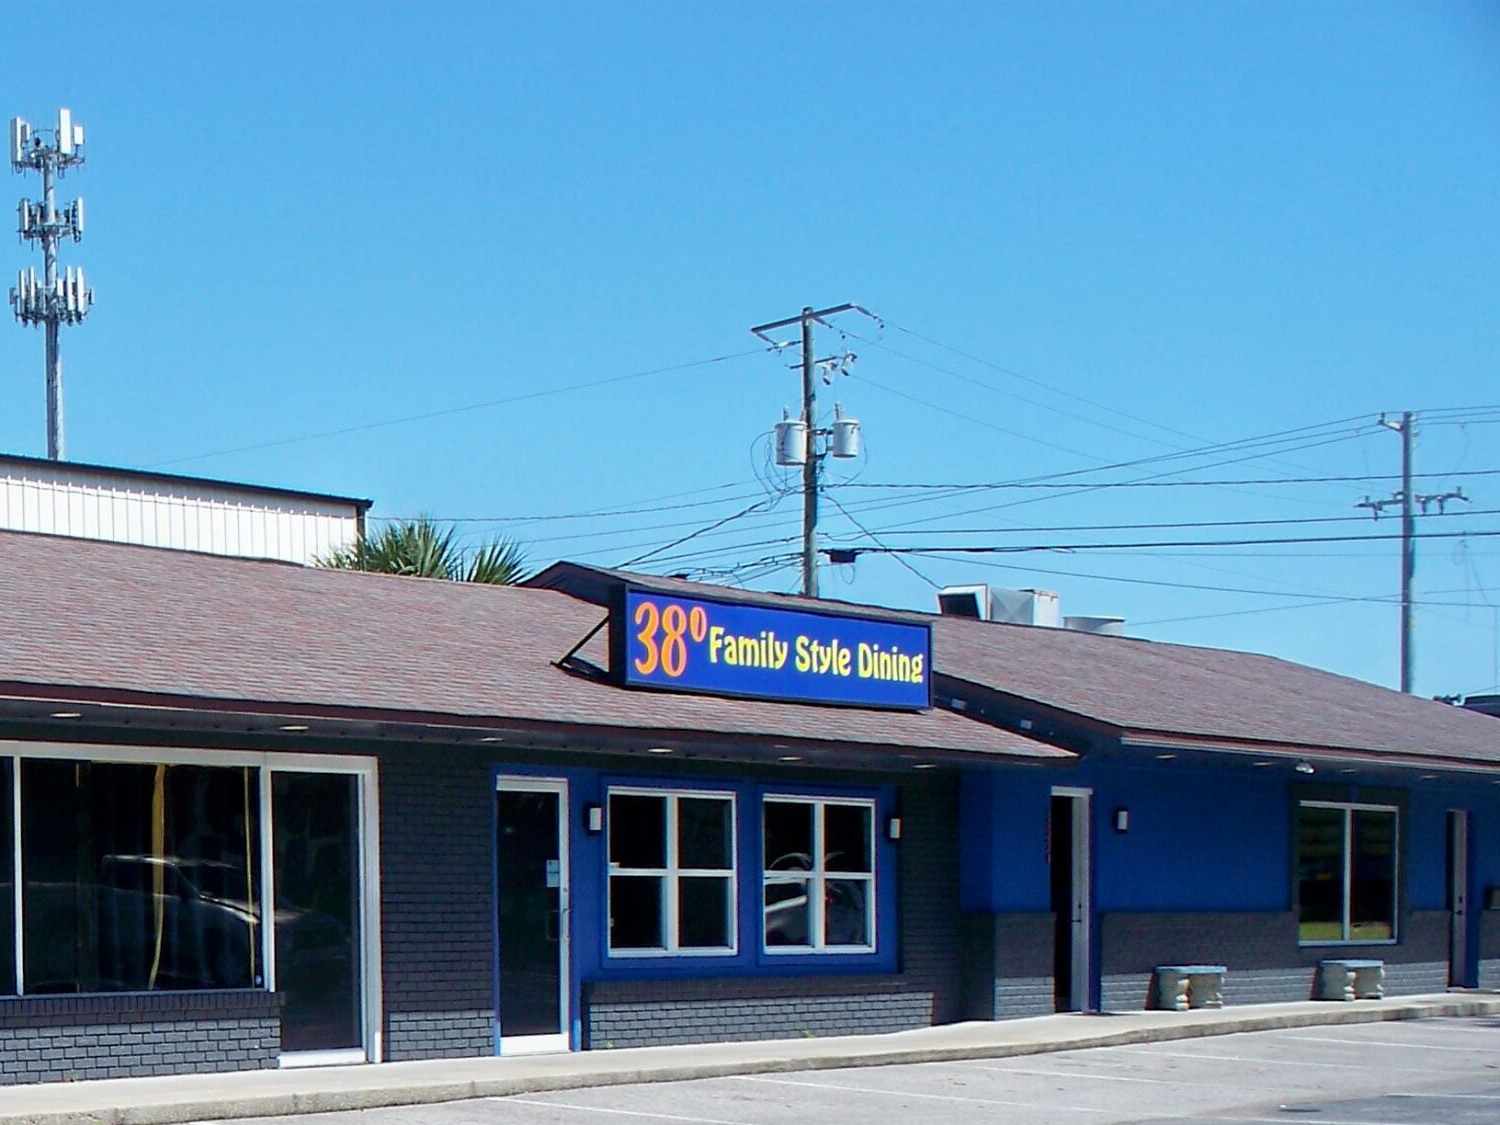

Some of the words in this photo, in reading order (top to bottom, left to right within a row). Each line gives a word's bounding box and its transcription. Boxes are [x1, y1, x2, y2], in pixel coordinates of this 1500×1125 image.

[709, 626, 788, 670] Family
[795, 635, 851, 676] Style
[858, 643, 924, 684] Dining
